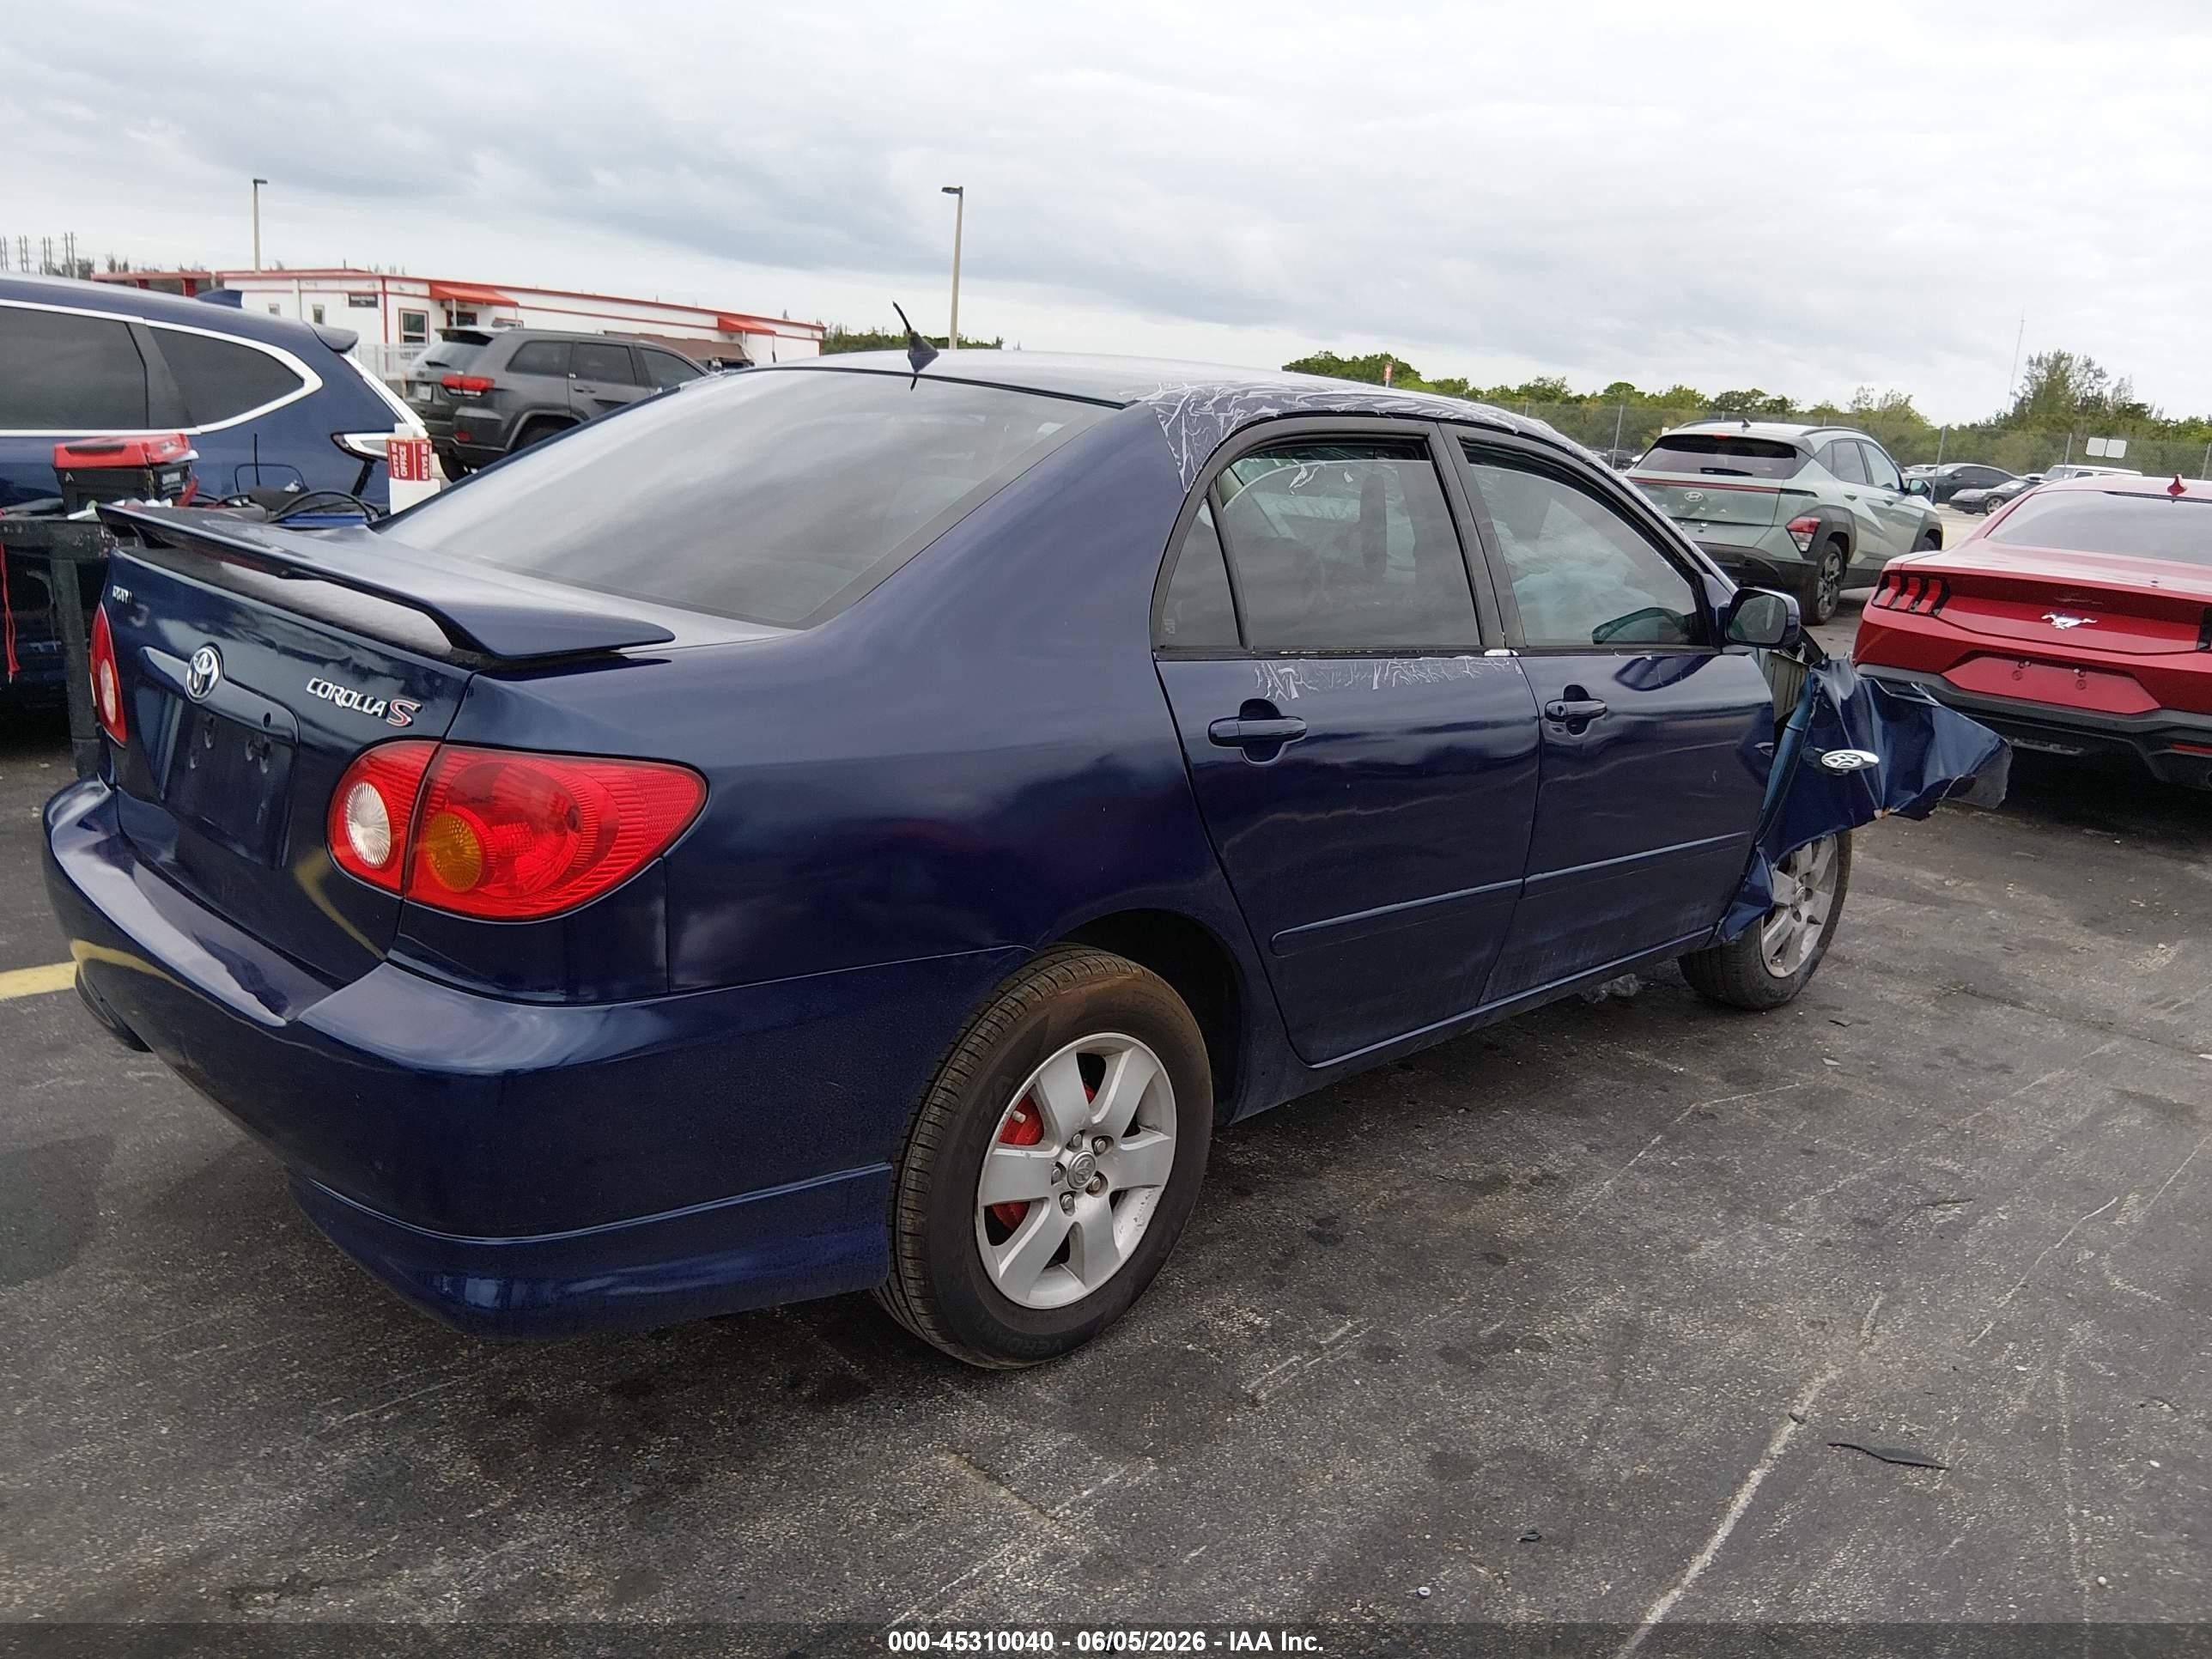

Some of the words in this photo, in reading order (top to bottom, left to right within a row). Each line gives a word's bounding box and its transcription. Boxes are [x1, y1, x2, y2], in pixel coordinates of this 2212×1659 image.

[392, 454, 400, 478] KEYS
[398, 445, 408, 477] OFFICE
[306, 677, 388, 717] COROLLA
[386, 699, 423, 727] S
